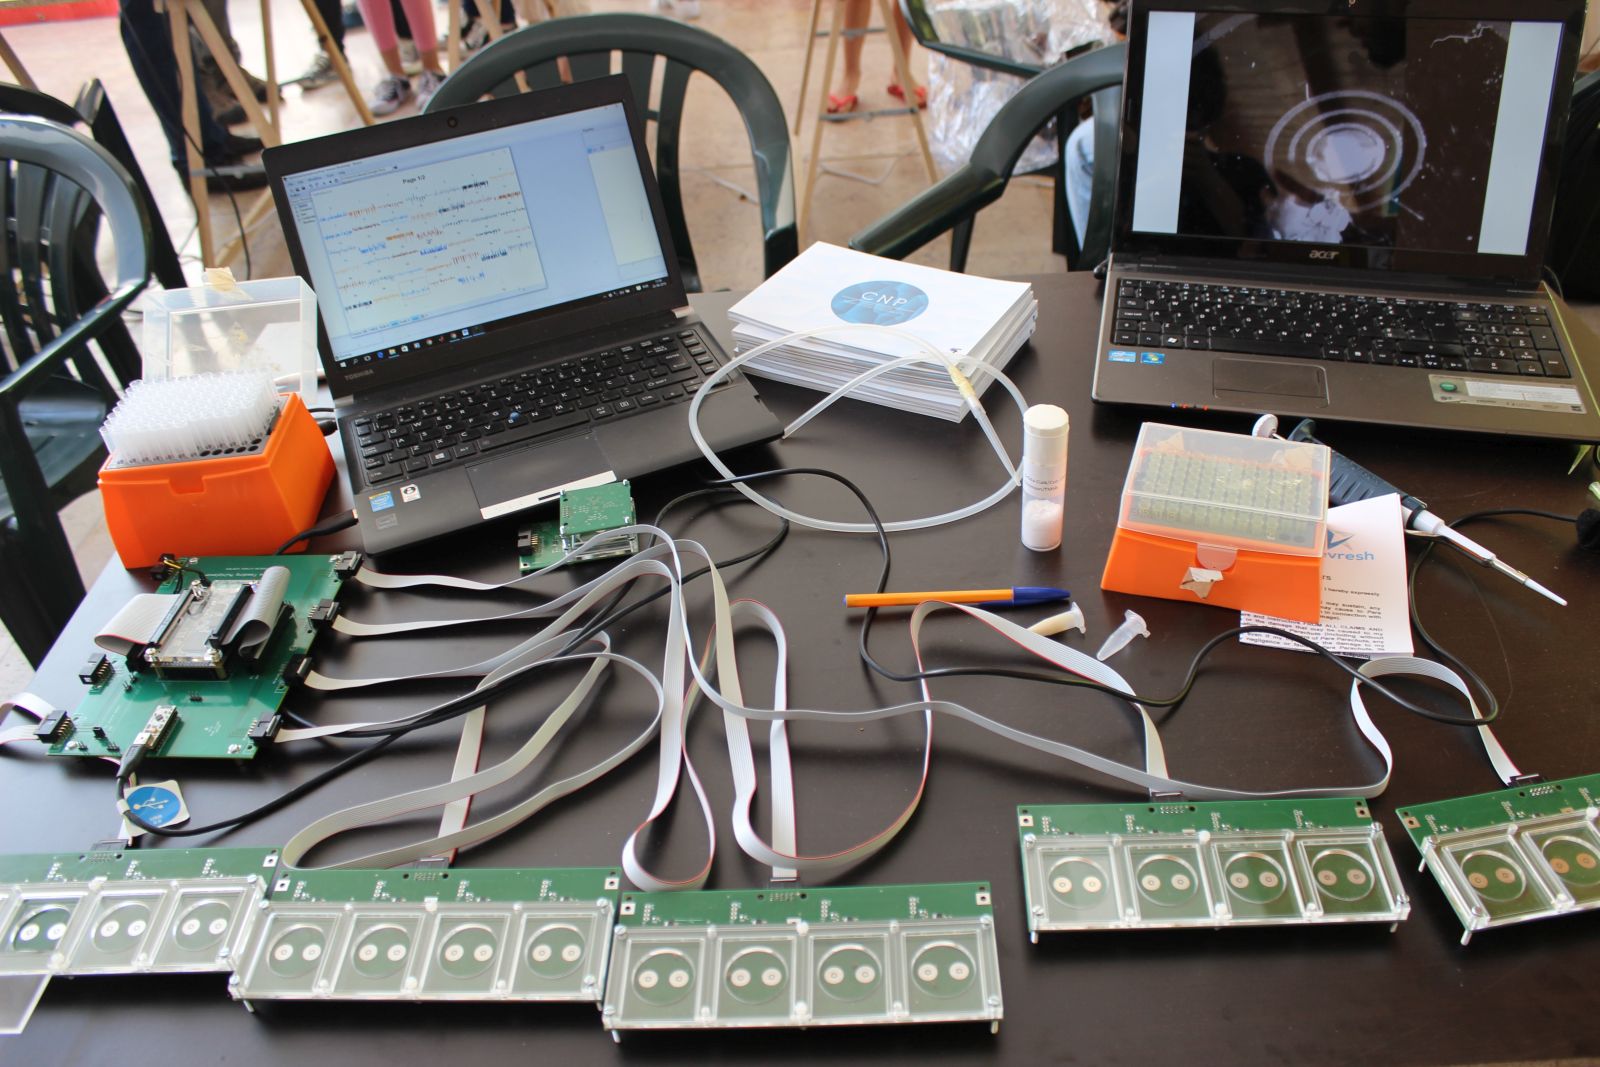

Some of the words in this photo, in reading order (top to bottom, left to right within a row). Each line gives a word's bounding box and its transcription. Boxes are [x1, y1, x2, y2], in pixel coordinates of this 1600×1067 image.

[1309, 250, 1340, 260] acer
[862, 292, 908, 306] CNP
[1268, 620, 1292, 629] damage
[1246, 638, 1280, 646] negligence
